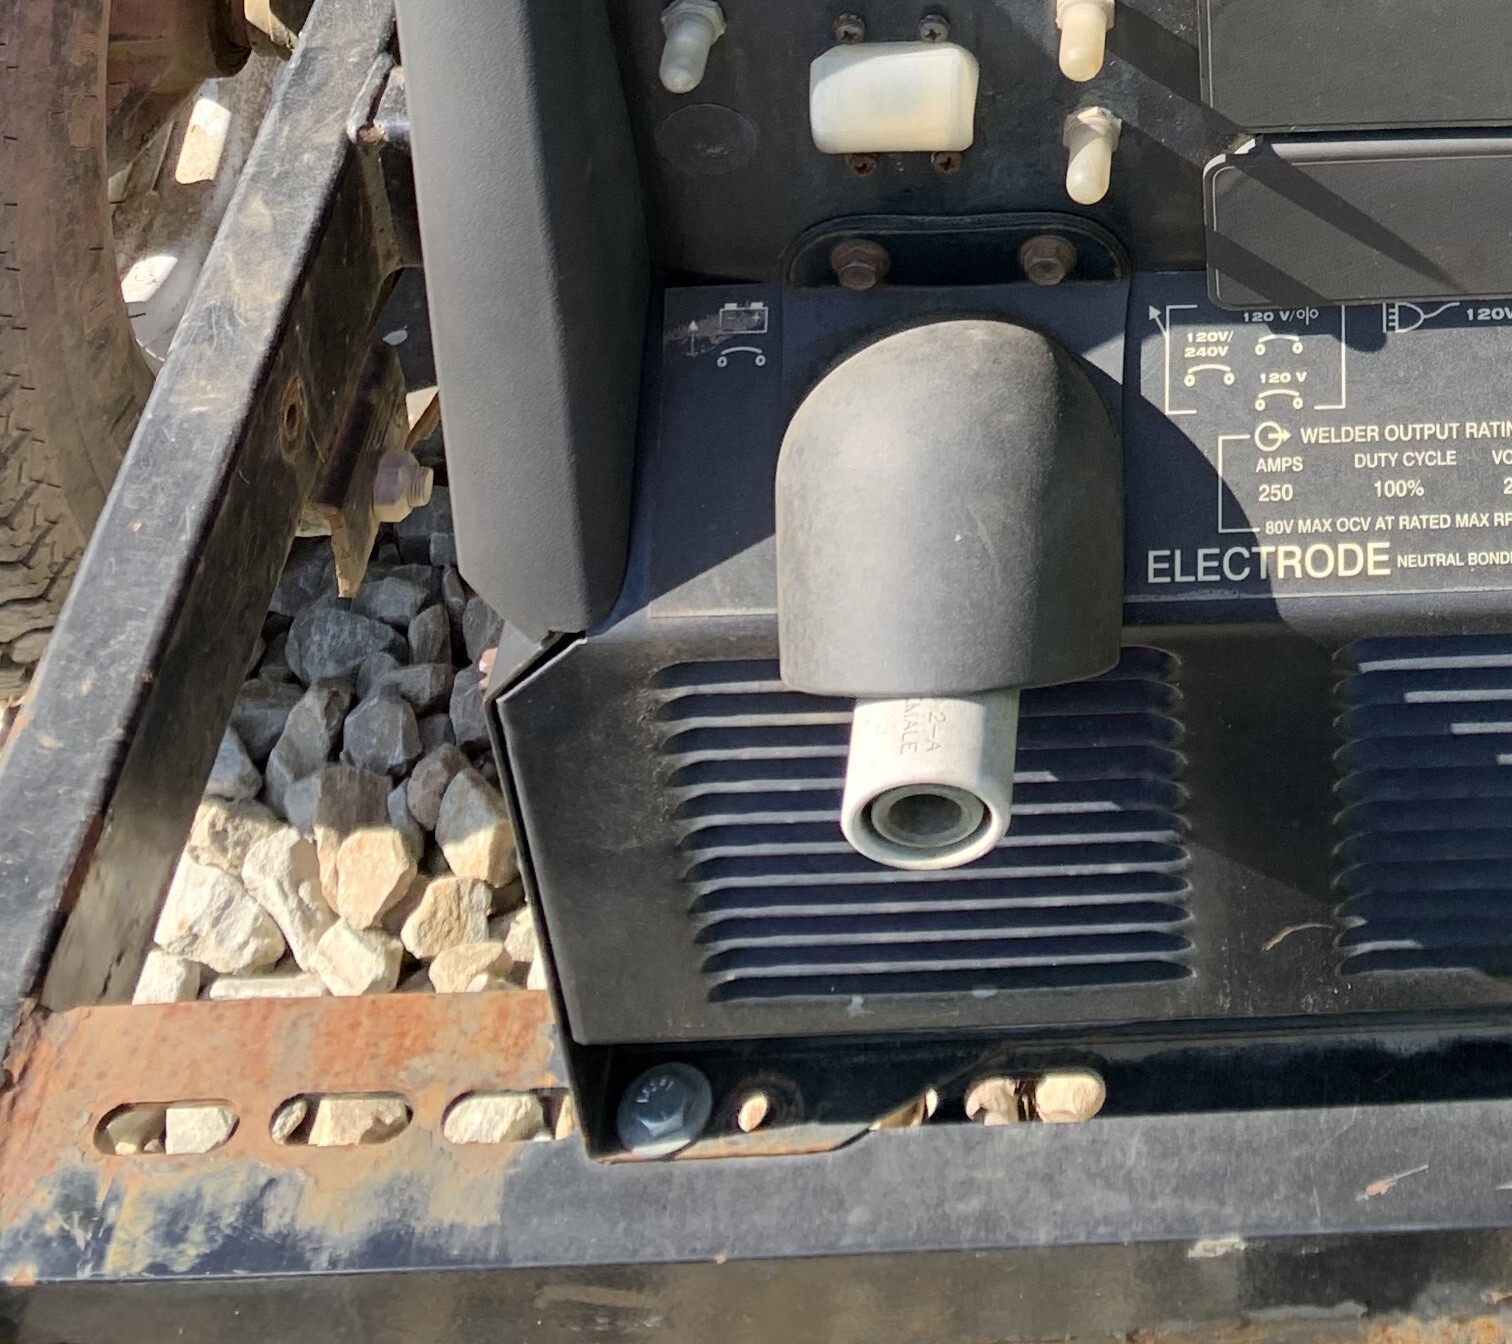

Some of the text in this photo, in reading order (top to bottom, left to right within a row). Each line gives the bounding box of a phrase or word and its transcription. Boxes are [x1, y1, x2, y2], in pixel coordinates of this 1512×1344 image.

[1243, 311, 1274, 323] 120
[1184, 346, 1229, 358] 240V
[1259, 372, 1308, 384] 120 V
[1300, 425, 1380, 445] WELDER
[1384, 423, 1461, 443] OUTPUT
[1256, 457, 1304, 473] AMPS
[1354, 453, 1398, 469] DUTY
[1402, 450, 1457, 467] CYCLE
[1258, 484, 1293, 503] 250
[1373, 480, 1425, 499] 100%
[1265, 520, 1294, 535] 80V
[1298, 518, 1332, 533] MAX
[1336, 517, 1372, 533] OCV
[1374, 516, 1396, 531] AT
[1399, 514, 1452, 530] RATED
[1455, 513, 1490, 528] MAX
[1147, 542, 1392, 584] ELECTRODE
[1397, 553, 1465, 569] NEUTRAL
